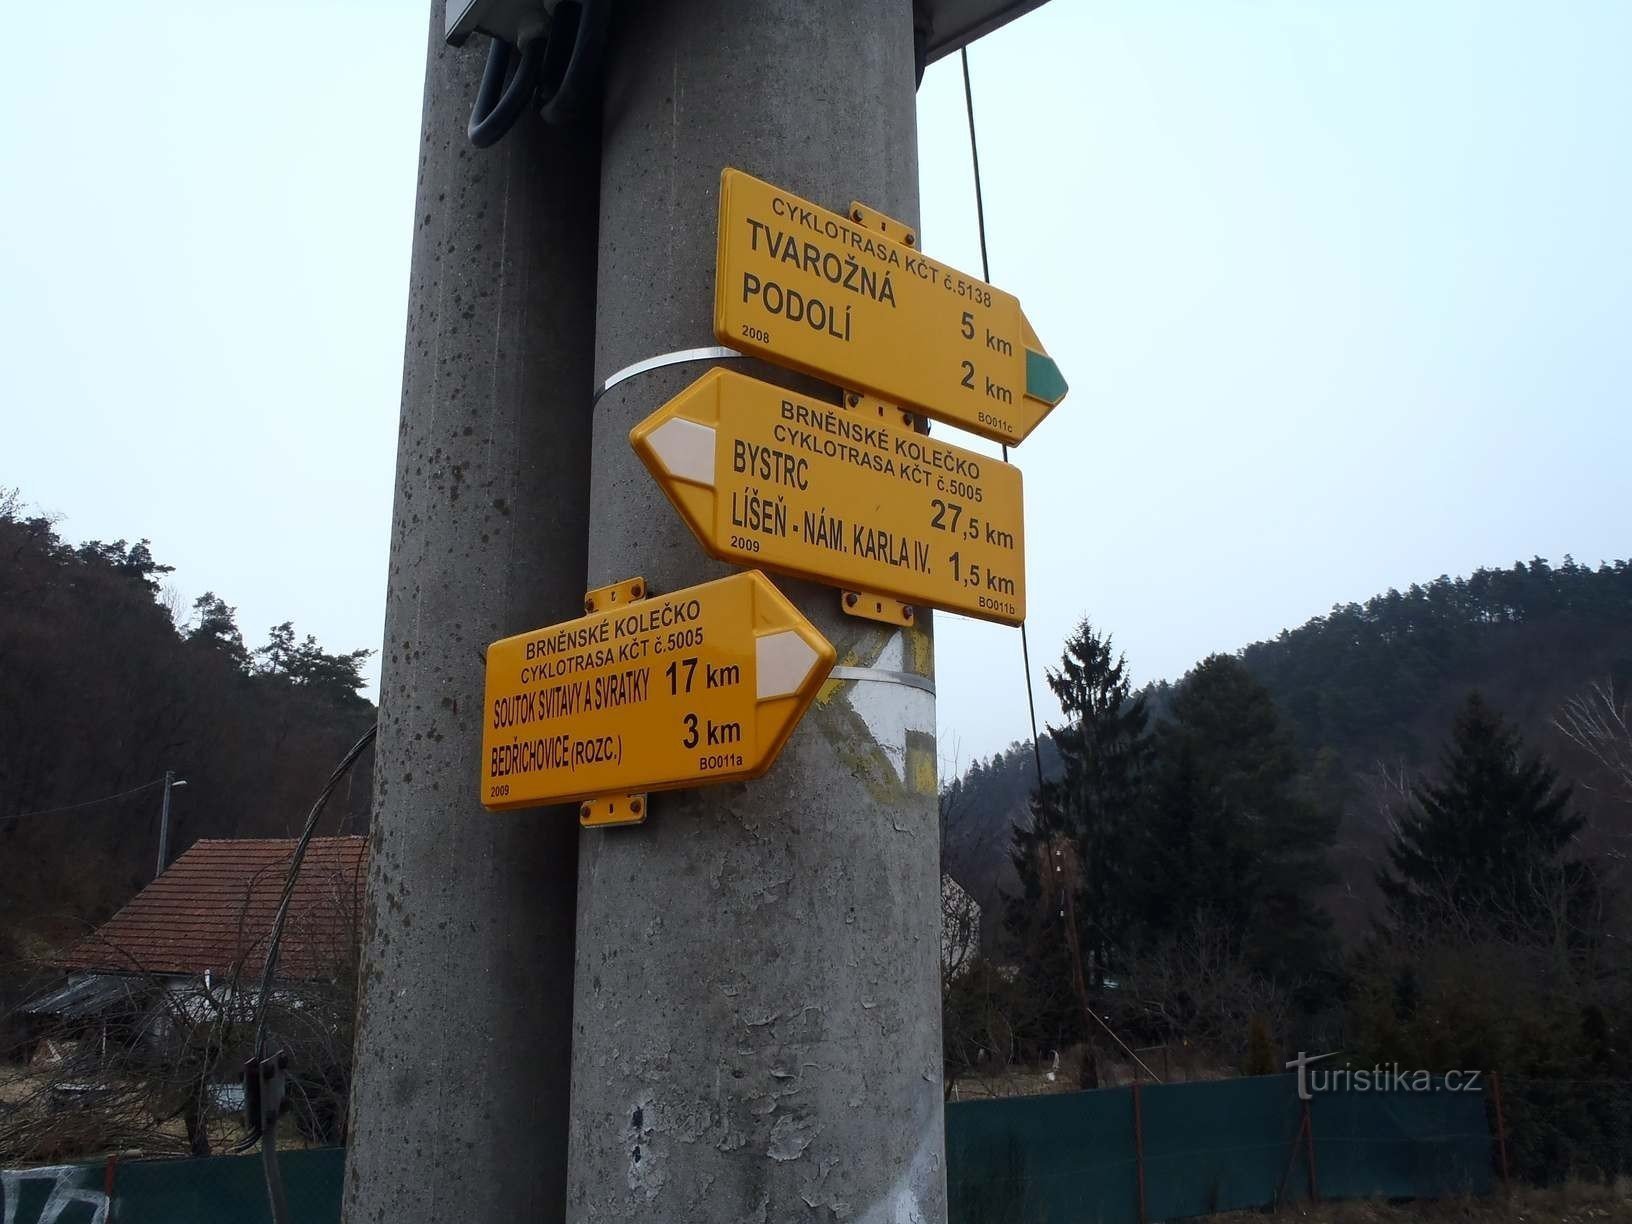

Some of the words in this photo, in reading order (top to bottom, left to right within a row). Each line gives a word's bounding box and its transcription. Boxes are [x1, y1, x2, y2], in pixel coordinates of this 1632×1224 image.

[772, 198, 900, 267] CYKLOTRASA
[905, 259, 939, 284] KČT
[943, 273, 992, 308] č.5138
[746, 218, 896, 308] TVAROŽNÁ
[961, 312, 974, 340] 5
[986, 329, 1012, 357] km
[742, 325, 769, 343] 2008
[743, 272, 851, 341] PODOLÍ
[961, 361, 975, 390] 2
[986, 377, 1012, 404] km
[781, 400, 889, 451] BRNĚNSKÉ
[896, 442, 980, 479] KOLEČKO
[978, 412, 1013, 433] BO011c
[734, 439, 808, 490] BYSTRC
[930, 499, 979, 542] 27,5
[986, 523, 1013, 549] km
[774, 424, 895, 476] CYKLOTRASA
[901, 464, 931, 487] KČT
[937, 476, 982, 502] č.5005
[731, 536, 760, 553] 2009
[733, 487, 786, 537] LÍŠEŇ
[804, 508, 847, 553] NÁM.
[854, 524, 909, 571] KARLA
[914, 542, 931, 574] IV.
[949, 552, 980, 587] 1,5
[987, 570, 1014, 595] km
[526, 619, 609, 660] BRNĚNSKÉ
[615, 599, 700, 635] KOLEČKO
[979, 596, 1015, 615] BO011b
[521, 650, 614, 684] CYKLOTRASA
[619, 639, 648, 660] KČT
[654, 627, 703, 654] č.5005
[494, 690, 535, 729] SOUTOK
[538, 680, 581, 720] SVITAVY
[584, 682, 592, 711] A
[595, 667, 650, 709] SVRATKY
[666, 657, 698, 696] 17
[706, 662, 739, 688] km
[491, 735, 569, 777] BEDŘICHOVICE
[571, 736, 622, 771] (ROZC.)
[683, 713, 699, 749] 3
[708, 720, 740, 745] km
[700, 755, 742, 771] BO011a
[491, 785, 509, 797] 2009
